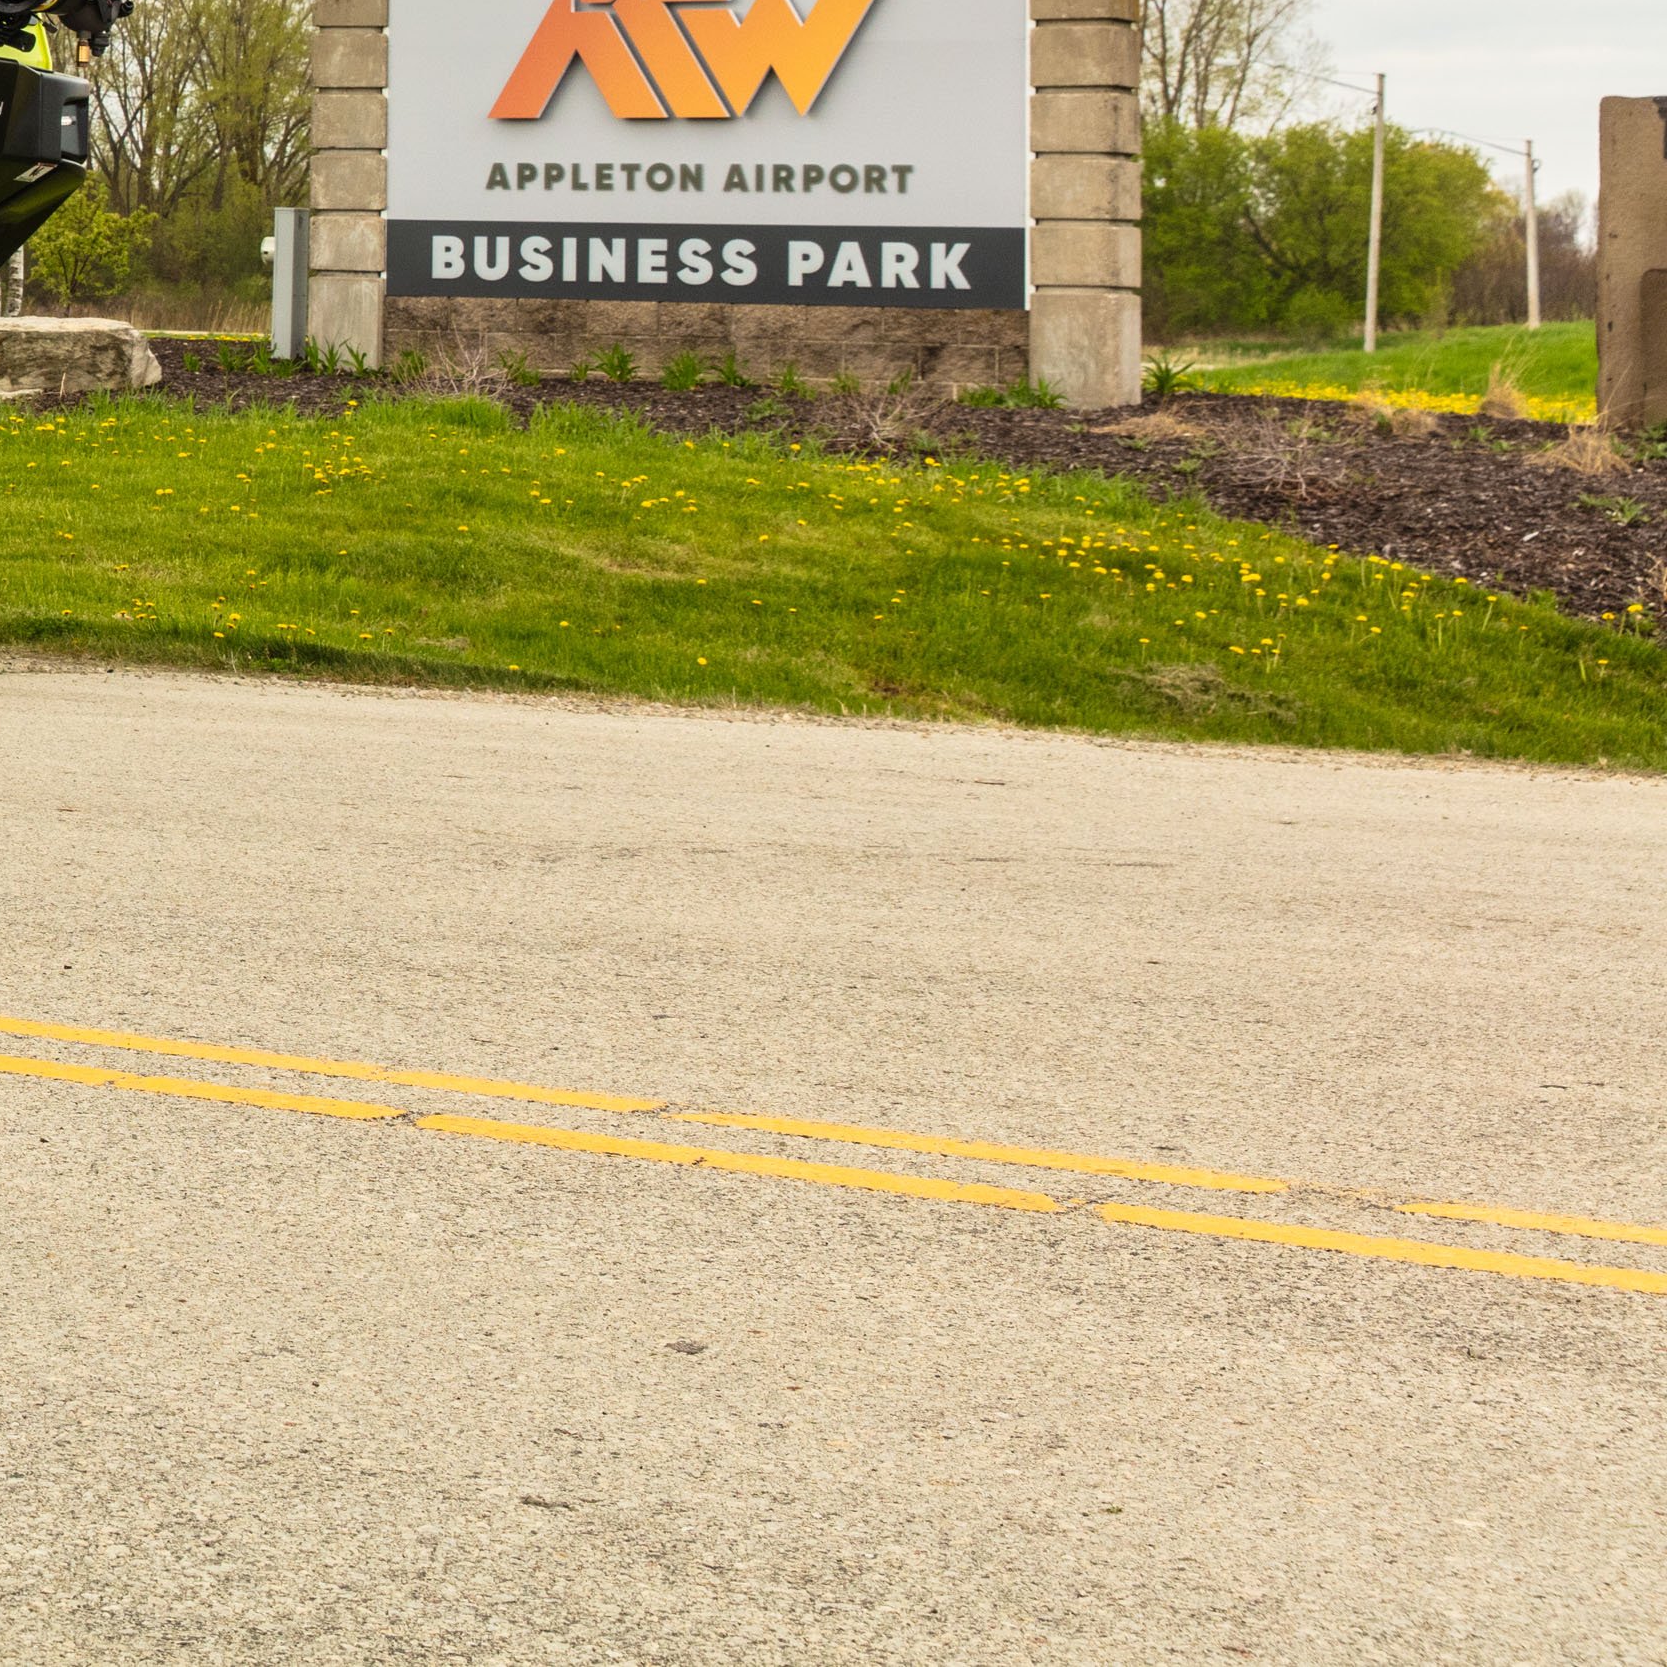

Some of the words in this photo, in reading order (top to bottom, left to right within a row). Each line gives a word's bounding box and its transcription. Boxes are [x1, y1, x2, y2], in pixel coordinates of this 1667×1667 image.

[485, 162, 704, 193] APPLETON
[723, 163, 914, 194] AIRPORT
[431, 235, 758, 286] BUSINESS
[787, 240, 971, 290] PARK
